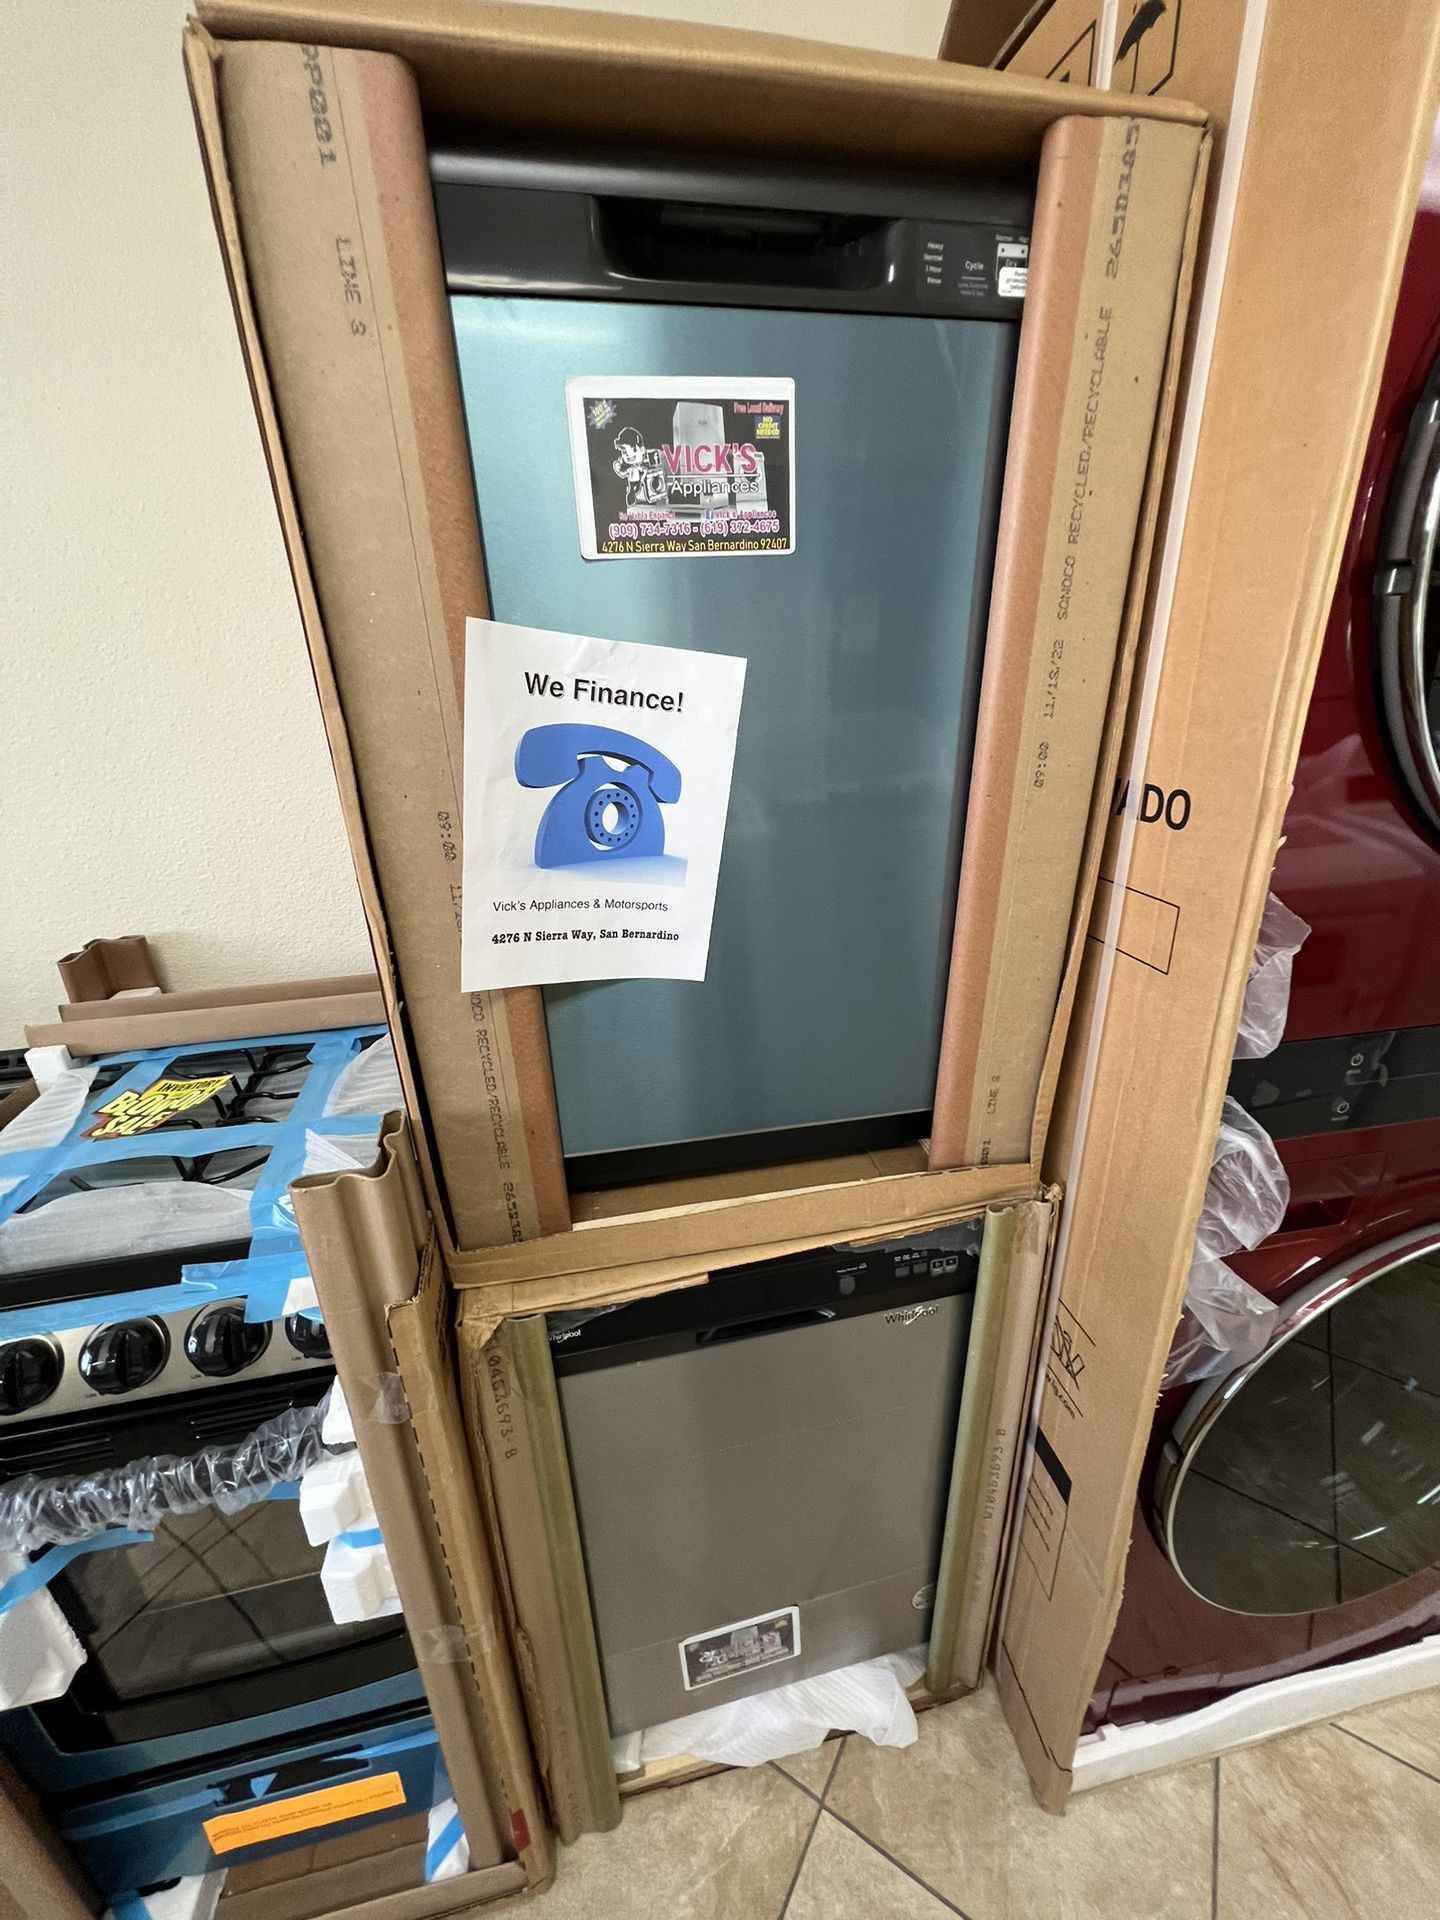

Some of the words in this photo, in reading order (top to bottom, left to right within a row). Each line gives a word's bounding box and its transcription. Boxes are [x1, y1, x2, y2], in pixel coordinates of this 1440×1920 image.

[923, 252, 943, 261] Normal
[965, 260, 984, 271] Cycle
[336, 237, 362, 304] LINE
[662, 443, 757, 475] VICK'S
[671, 479, 759, 498] Appliances
[739, 509, 777, 519] Appliances
[608, 523, 639, 540] (909)
[640, 521, 691, 537] 734-7316
[700, 521, 728, 538] (619)
[730, 519, 780, 535] 372-4675
[602, 540, 625, 553] 4276
[626, 541, 635, 552] N
[636, 540, 665, 552] Sierra
[666, 540, 688, 554] Way
[688, 540, 706, 552] San
[707, 539, 759, 551] Bernardino
[760, 537, 787, 550] 92407
[1057, 555, 1076, 621] SONOCO
[524, 672, 565, 698] We
[573, 678, 686, 713] Finance!
[492, 900, 526, 913] Vick's
[529, 898, 590, 911] Appliances
[593, 899, 601, 910] &
[604, 899, 669, 914] Motorsports
[491, 931, 520, 945] 4276
[523, 931, 533, 943] N
[535, 929, 569, 942] Sierra
[571, 928, 597, 943] Way,
[599, 928, 619, 940] San
[621, 928, 680, 942] Bernardino
[91, 1111, 173, 1137] SALE
[885, 1305, 939, 1325] Whirlpool
